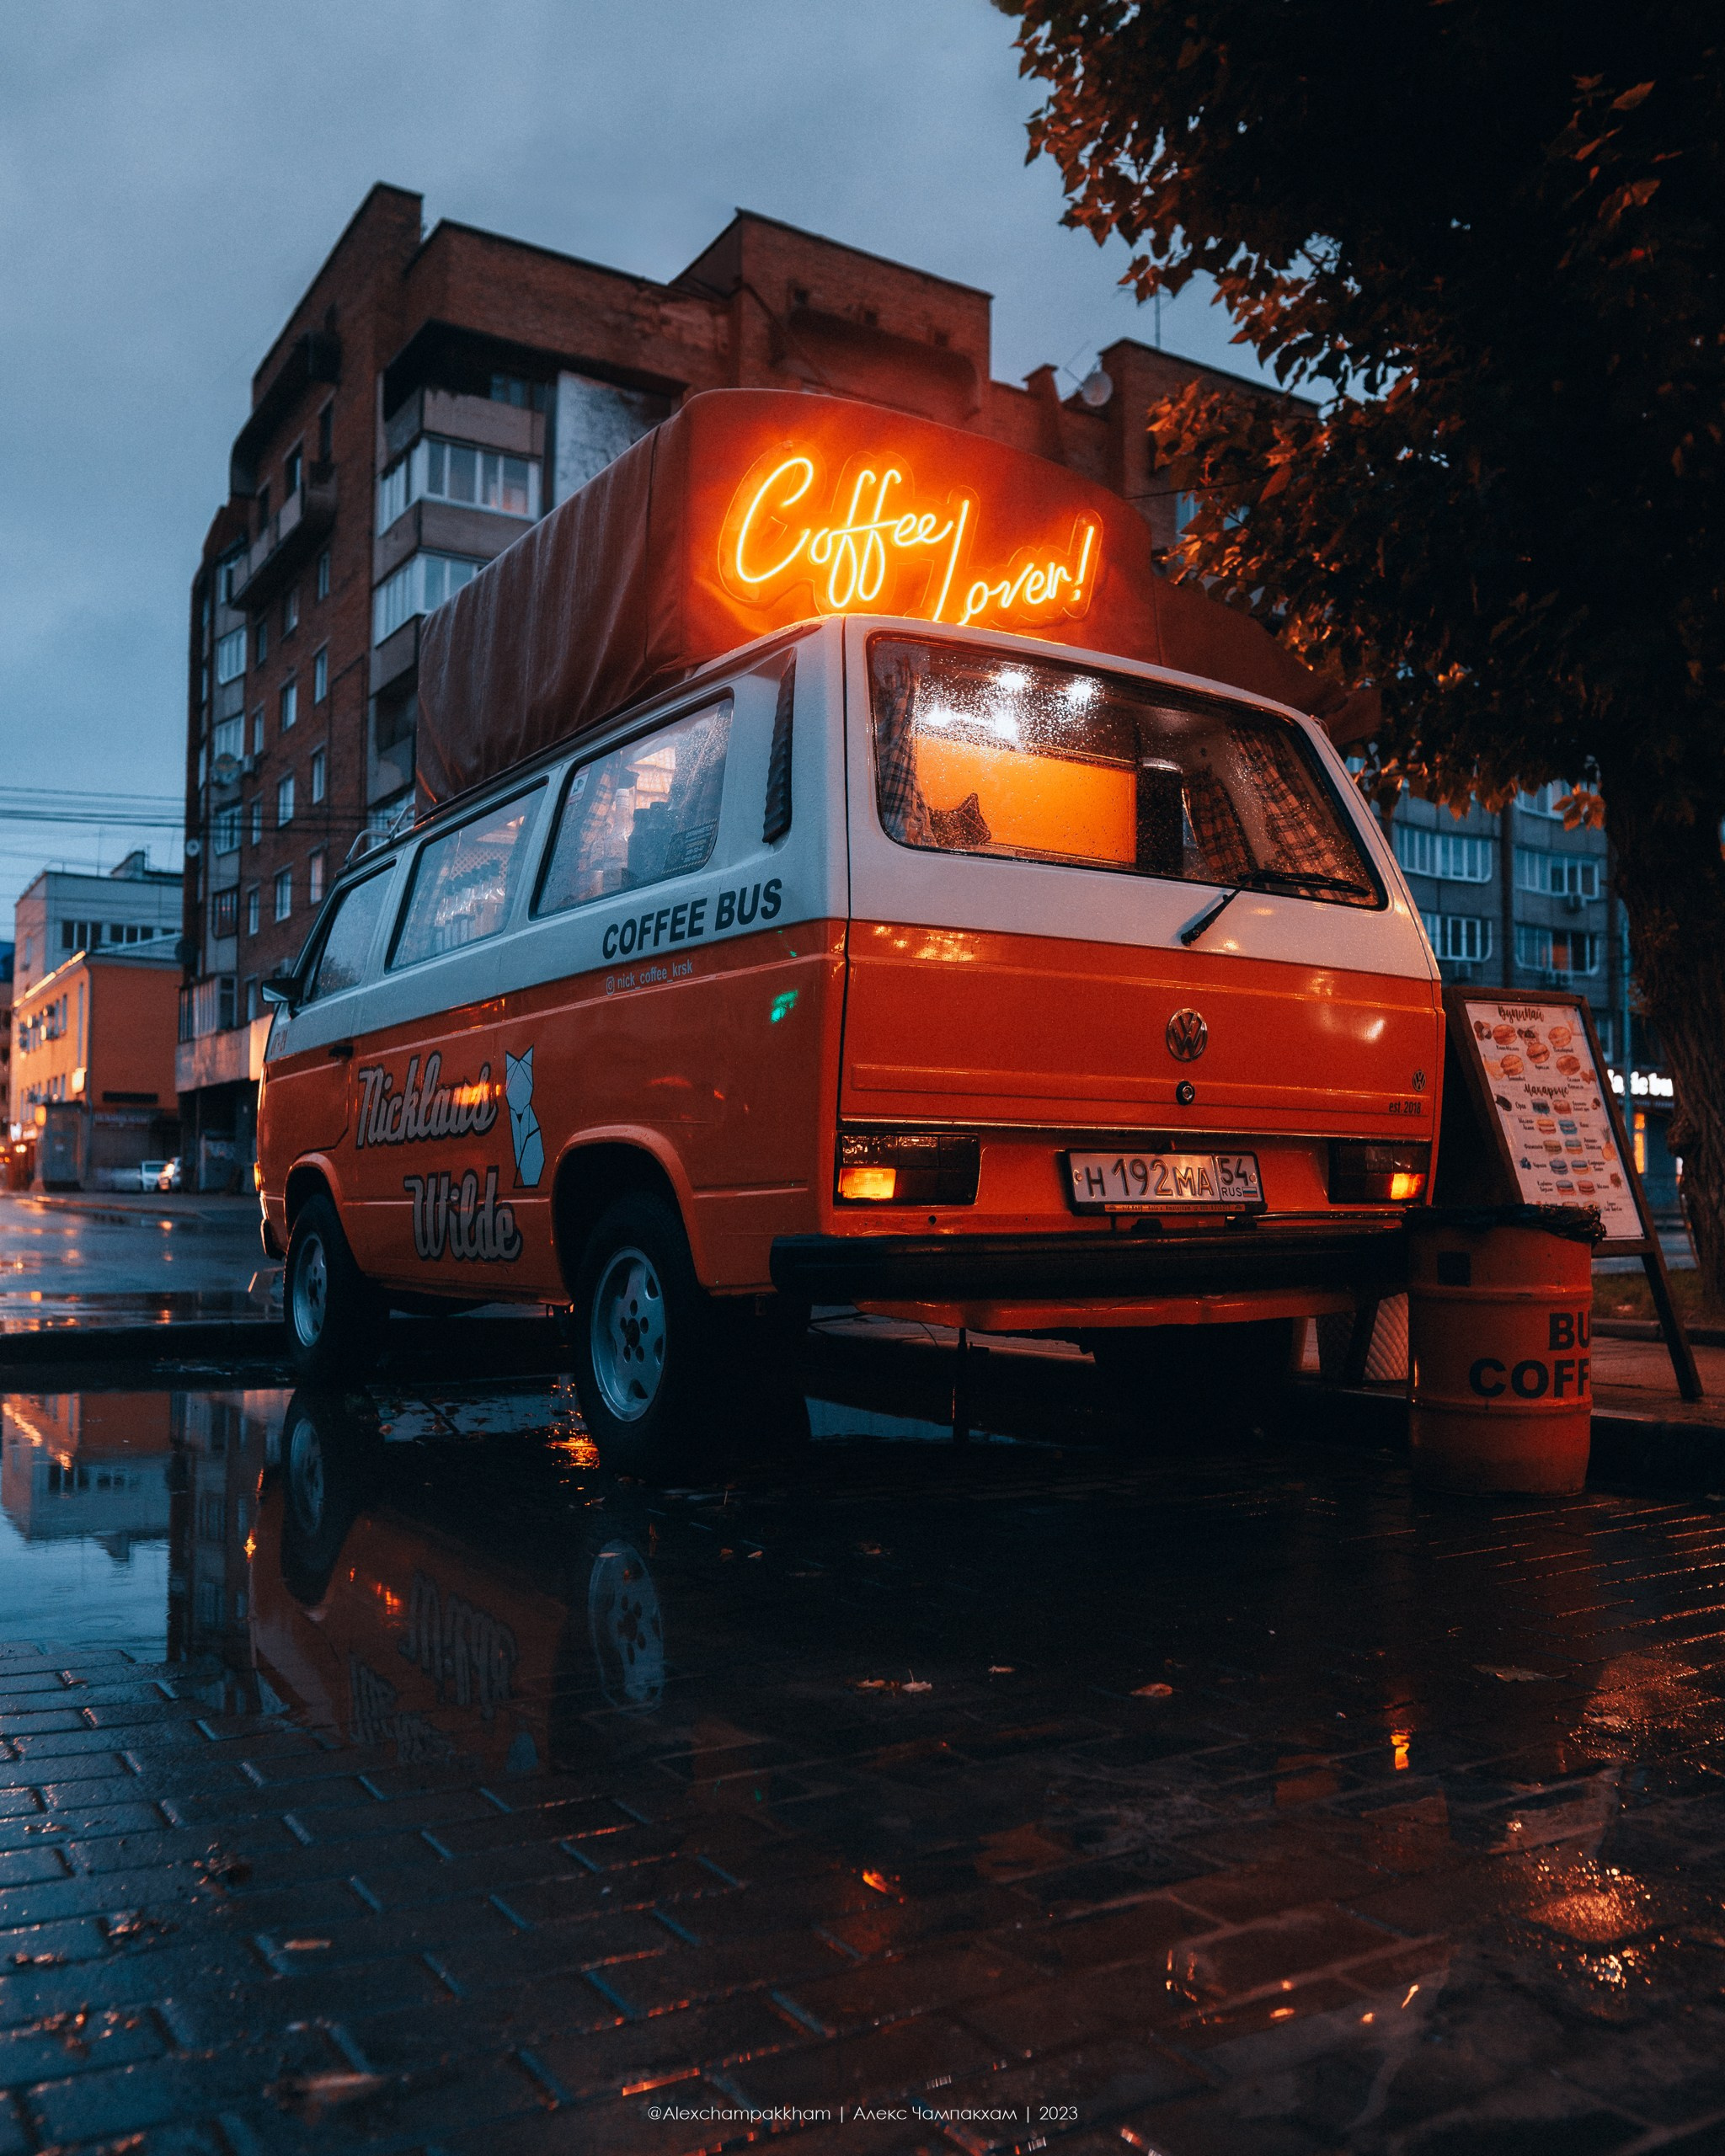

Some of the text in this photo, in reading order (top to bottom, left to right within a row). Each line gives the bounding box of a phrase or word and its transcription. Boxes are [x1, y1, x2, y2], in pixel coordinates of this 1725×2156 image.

[734, 456, 954, 610] Coffee
[602, 878, 782, 960] COFFEE BUS
[617, 959, 693, 990] nick_coffee_krsk
[355, 1049, 499, 1150] Nicklaus
[1403, 1101, 1422, 1114] 2018
[1217, 1157, 1249, 1186] 54
[1221, 1187, 1242, 1198] RUS
[403, 1165, 524, 1262] Wilde
